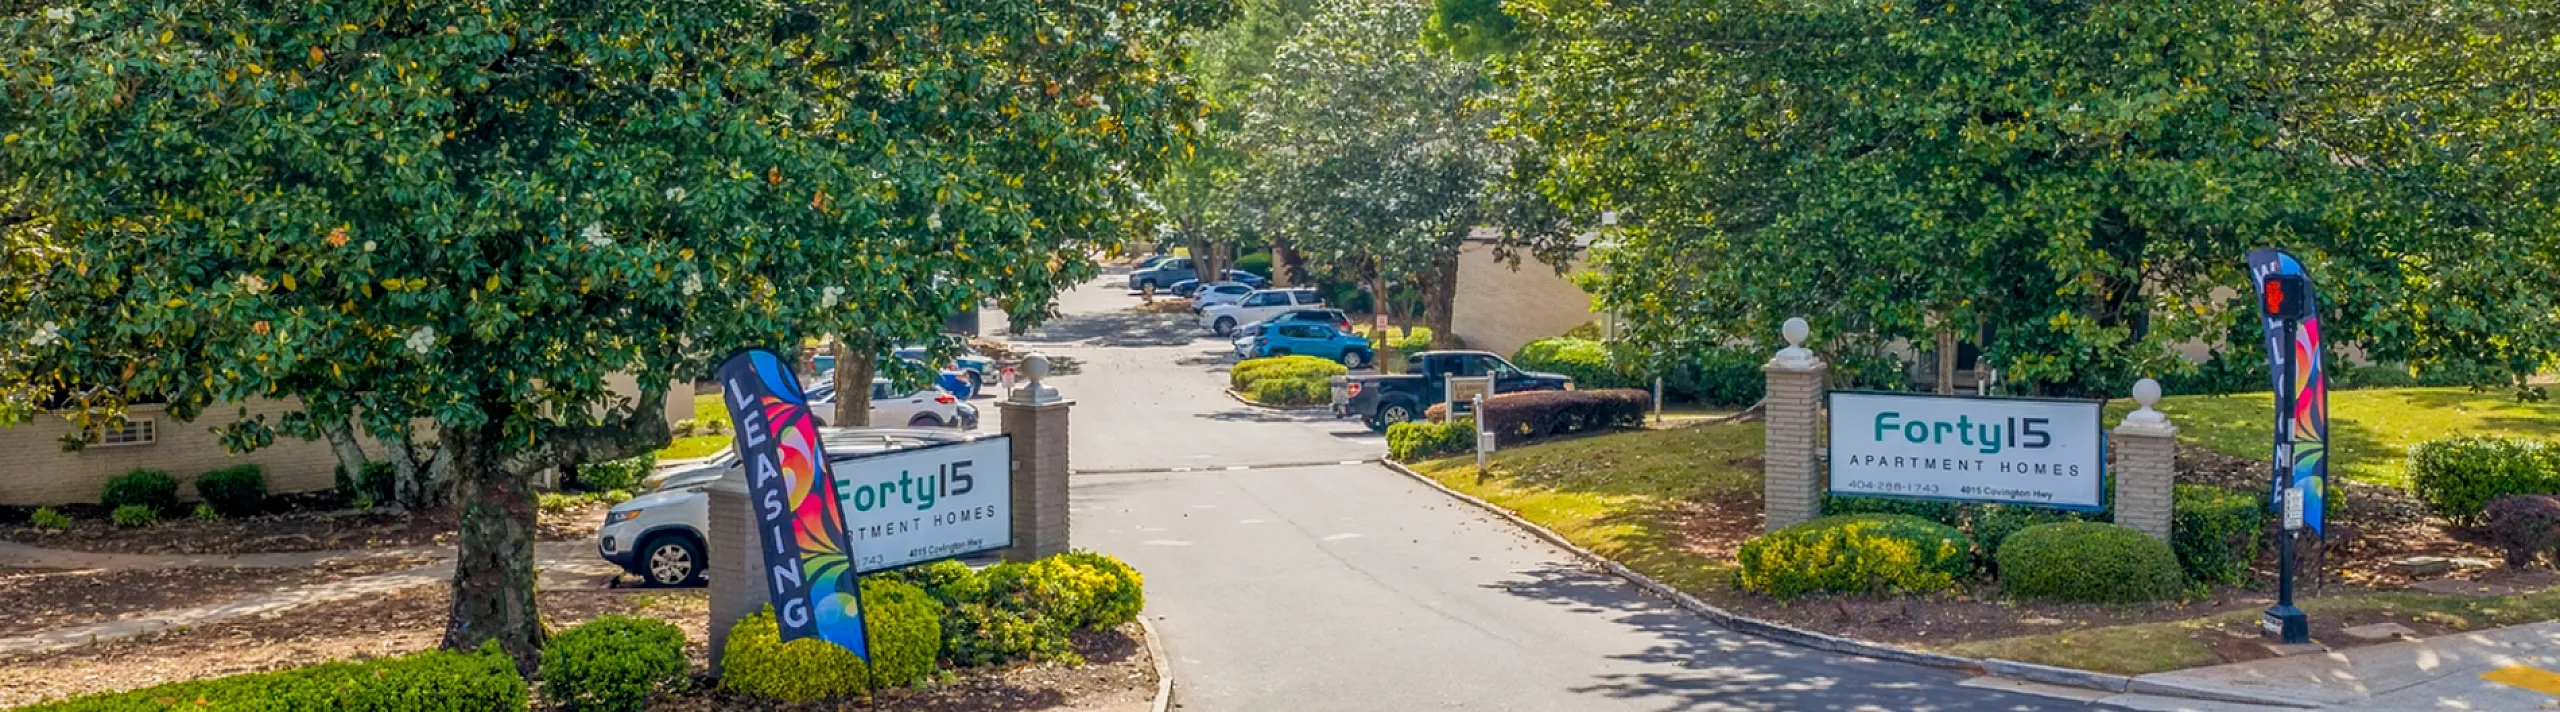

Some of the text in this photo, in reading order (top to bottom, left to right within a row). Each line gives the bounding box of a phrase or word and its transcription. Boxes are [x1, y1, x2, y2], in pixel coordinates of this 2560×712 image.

[1874, 411, 2051, 454] Forty15
[1849, 454, 2081, 477] APARTMENT HOMES
[729, 378, 808, 628] LEASING
[1960, 485, 2053, 500] 4015 Covington Hwy
[933, 504, 996, 528] HOMES
